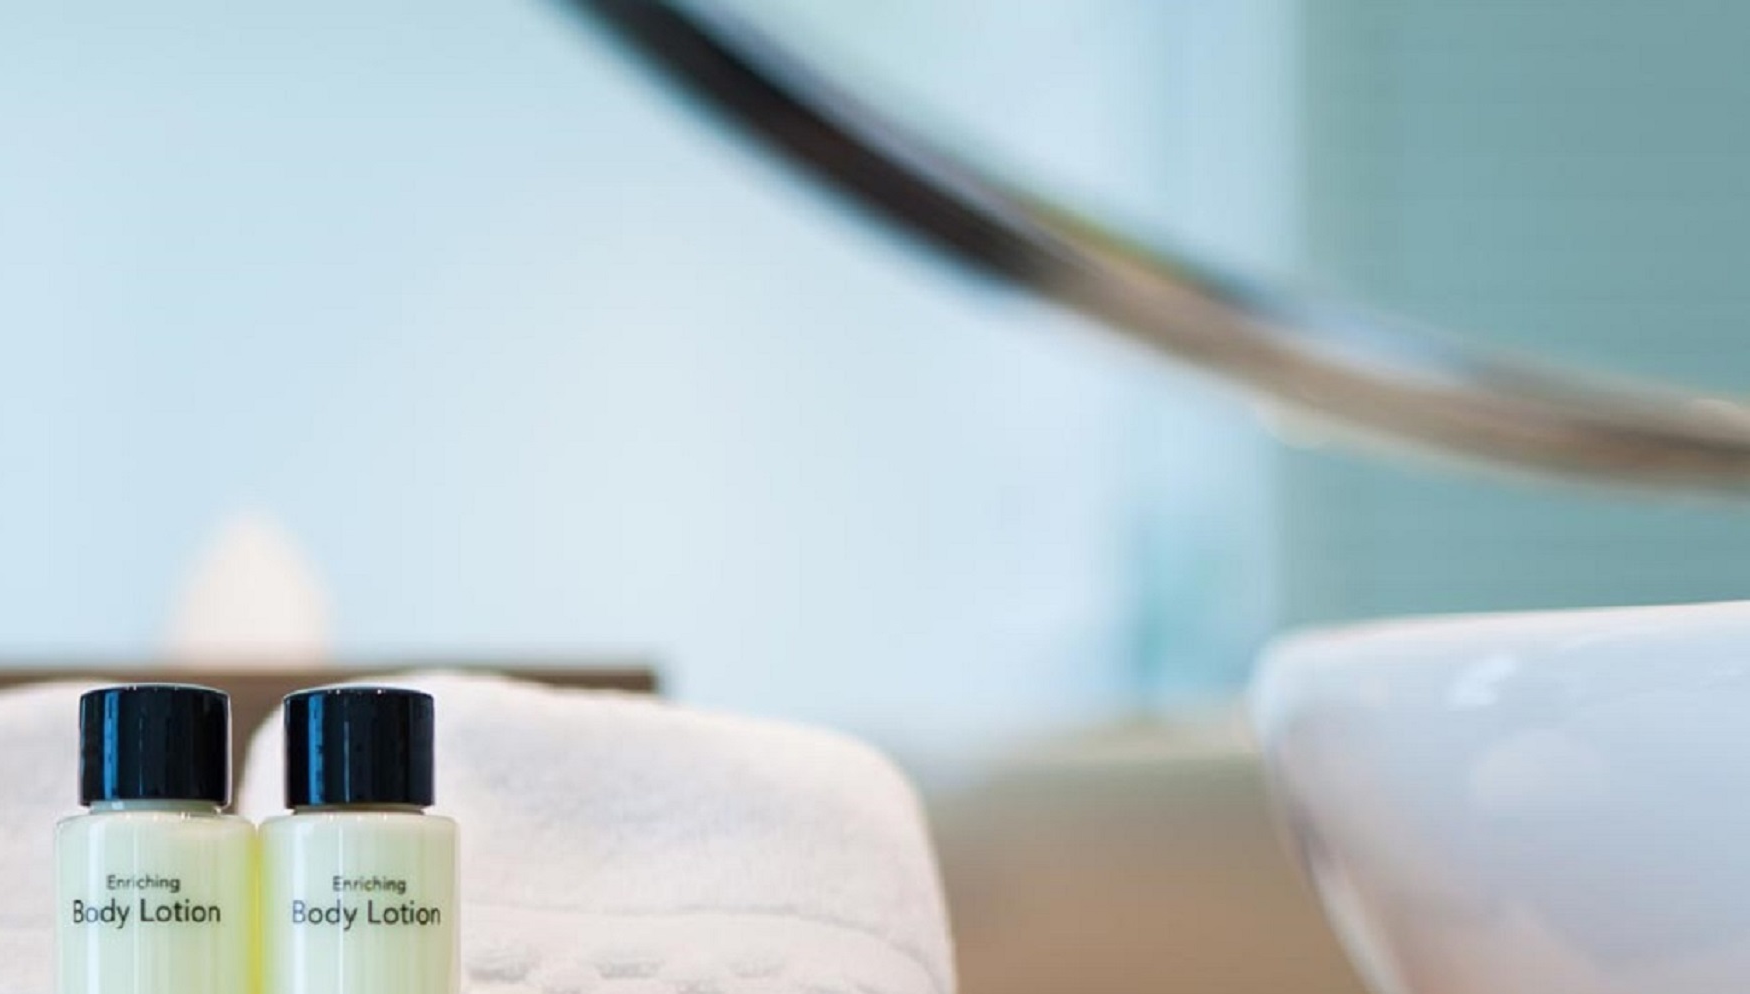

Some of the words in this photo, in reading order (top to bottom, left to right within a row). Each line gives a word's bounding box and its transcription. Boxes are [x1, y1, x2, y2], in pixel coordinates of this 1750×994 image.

[107, 874, 181, 893] Enriching
[333, 876, 407, 895] Enriching
[72, 899, 130, 929] Body
[140, 899, 221, 922] Lotion
[292, 900, 357, 930] Body
[367, 900, 441, 925] Lotion
